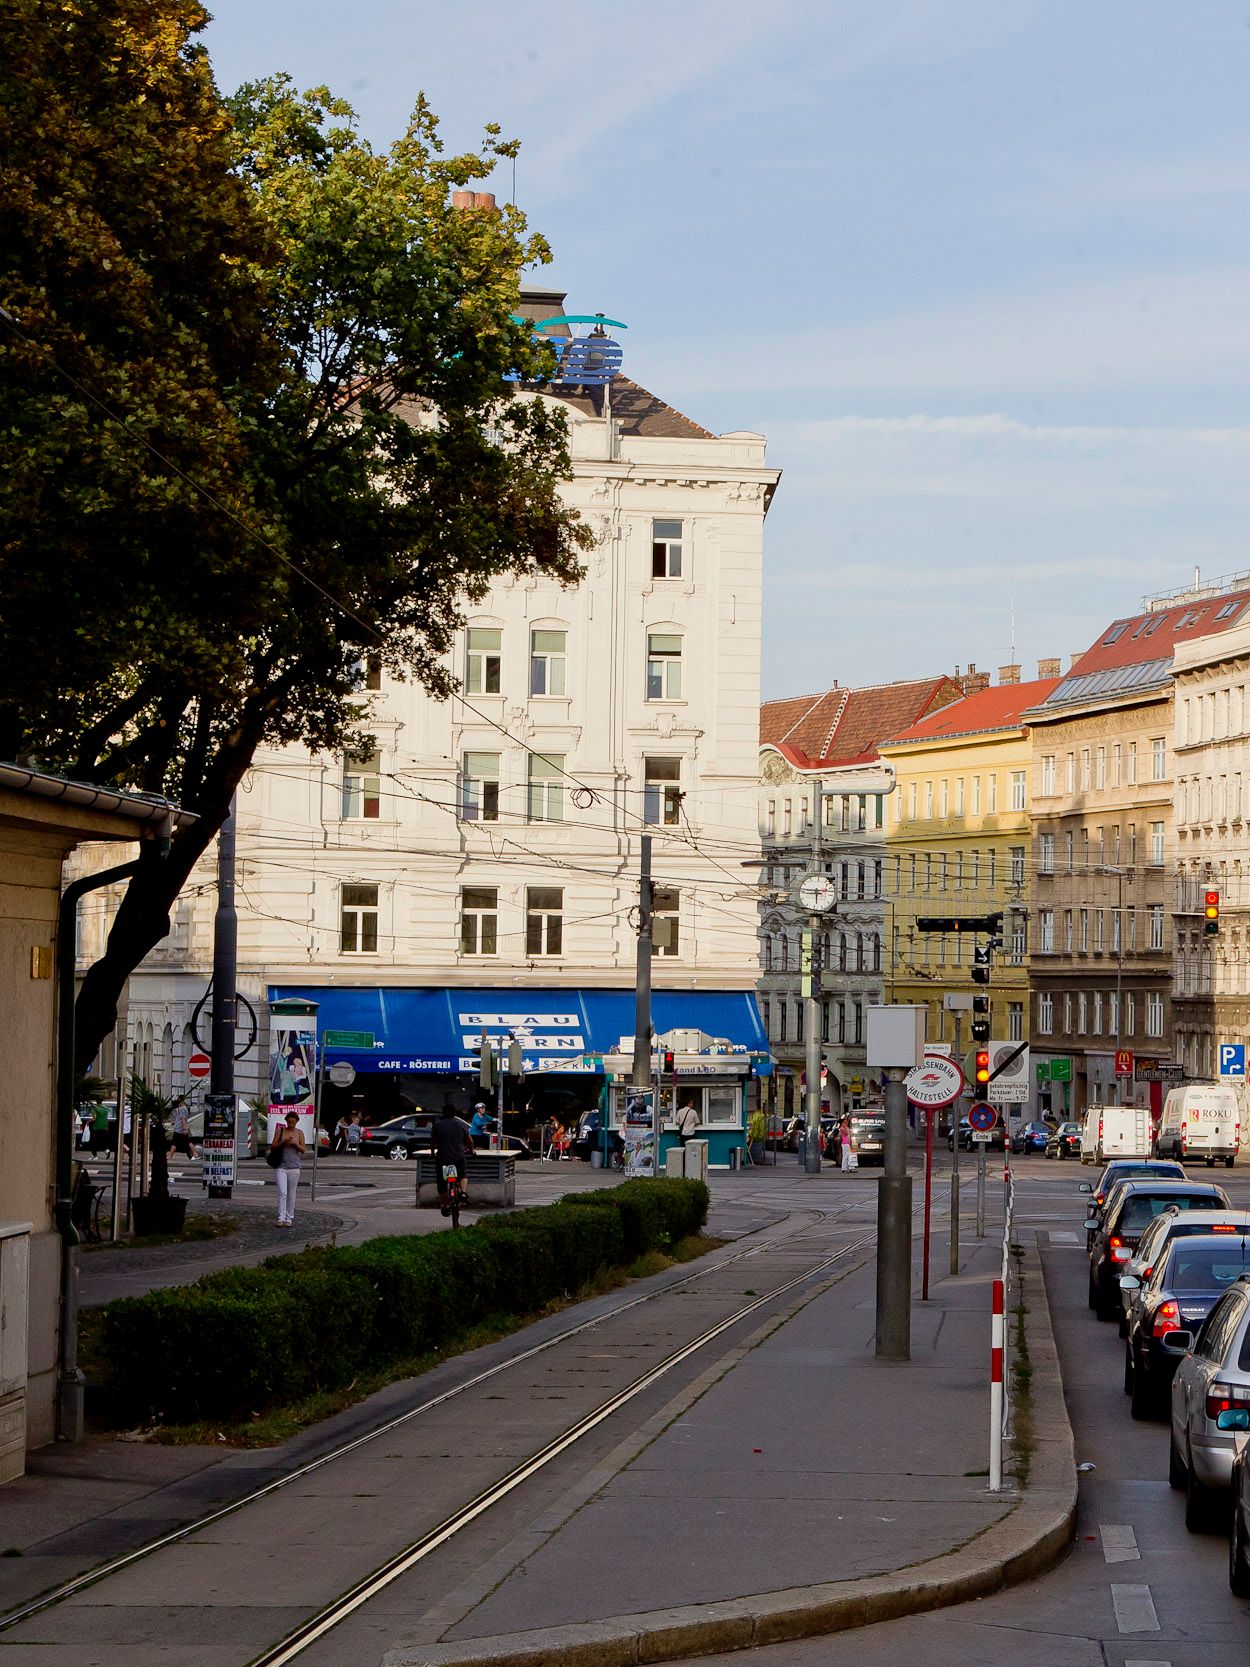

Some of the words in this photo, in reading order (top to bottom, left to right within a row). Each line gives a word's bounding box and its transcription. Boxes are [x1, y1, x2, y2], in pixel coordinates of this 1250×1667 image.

[468, 1015, 570, 1024] BLAU
[378, 1060, 400, 1069] CAFE
[409, 1059, 451, 1069] RÖSTEREI
[908, 1061, 956, 1080] STRASSENBAHN
[908, 1086, 954, 1101] HALTESTELLE
[1202, 1109, 1232, 1118] ROKU
